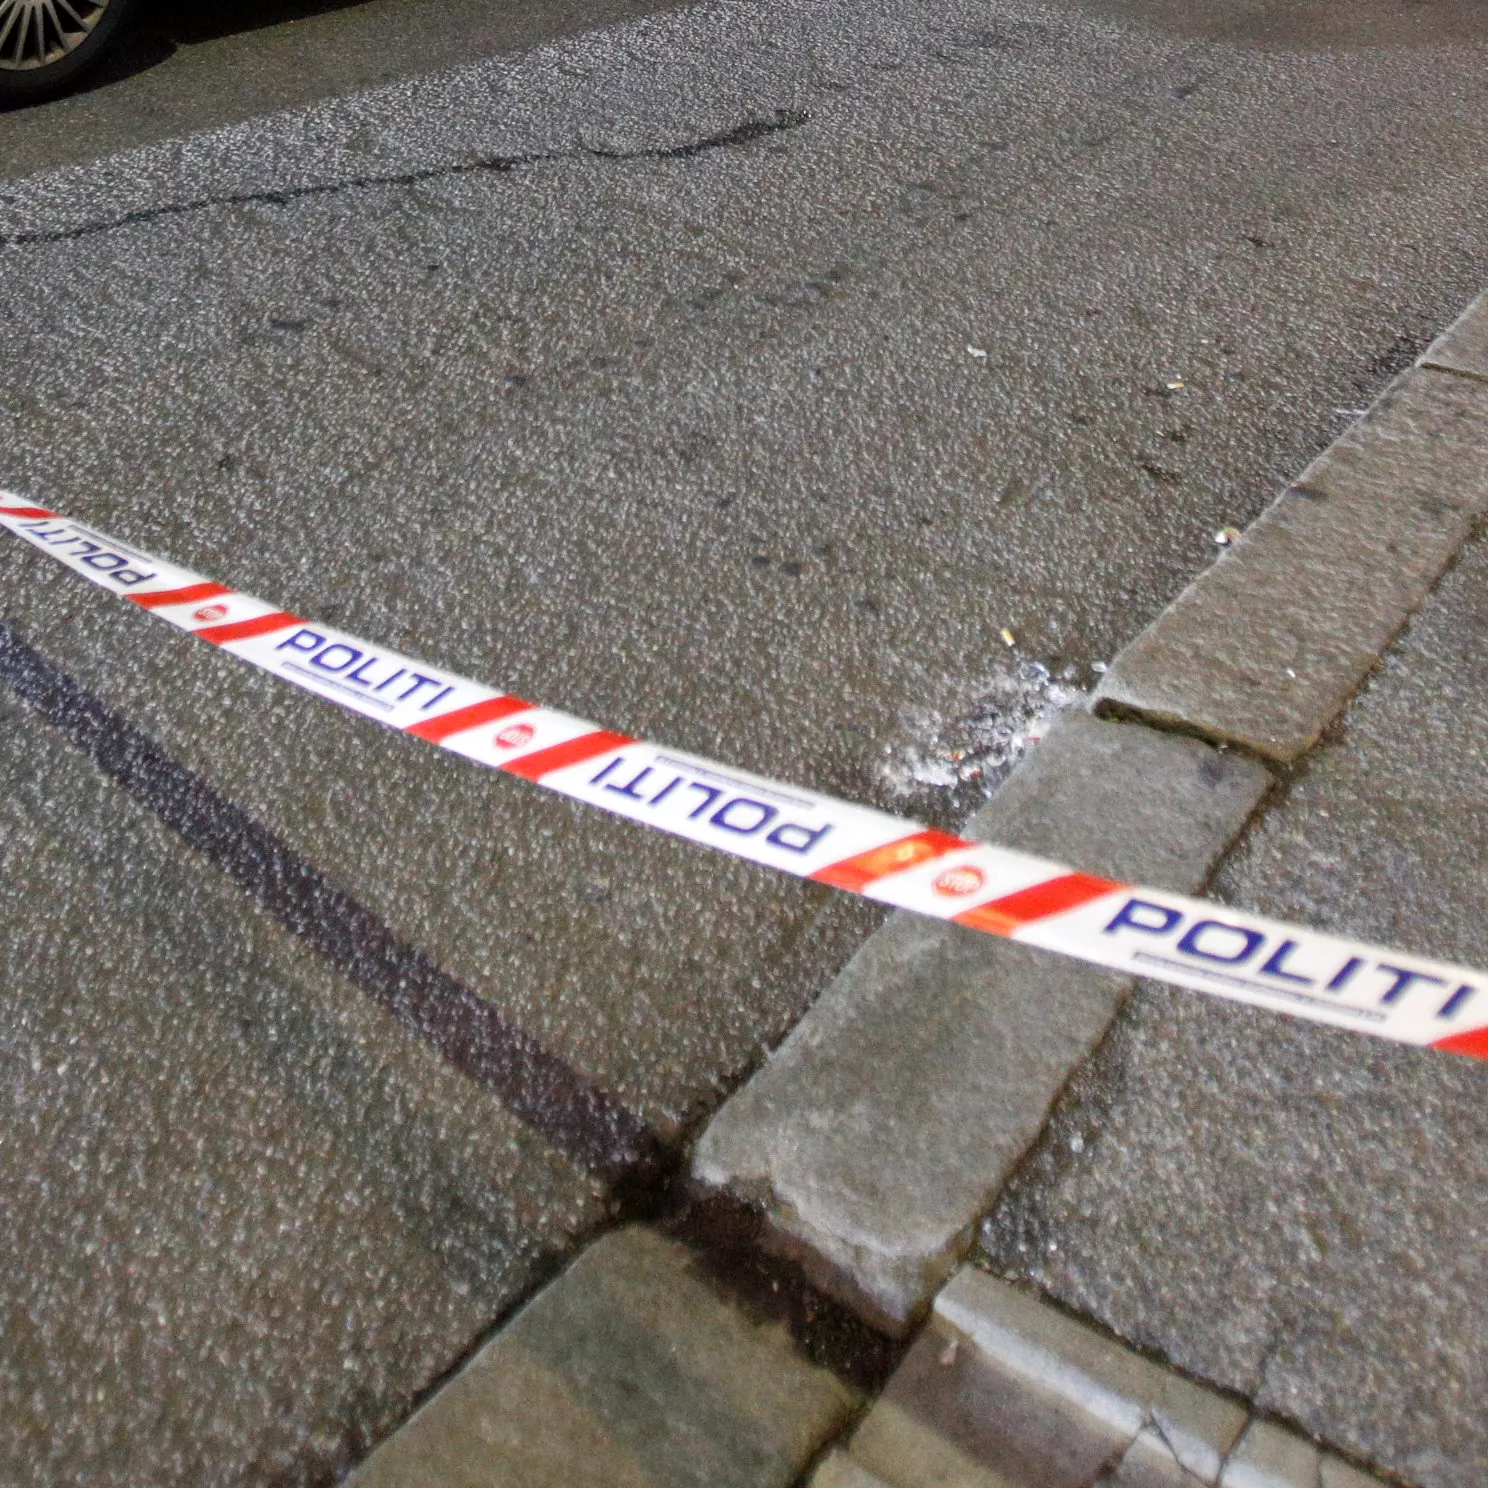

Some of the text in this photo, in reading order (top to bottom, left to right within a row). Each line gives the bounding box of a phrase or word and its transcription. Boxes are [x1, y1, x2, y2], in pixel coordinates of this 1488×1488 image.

[17, 521, 158, 586] POLITI
[274, 628, 456, 711] POLITI
[587, 756, 834, 855] POLITI
[1103, 896, 1481, 1021] POLITI
